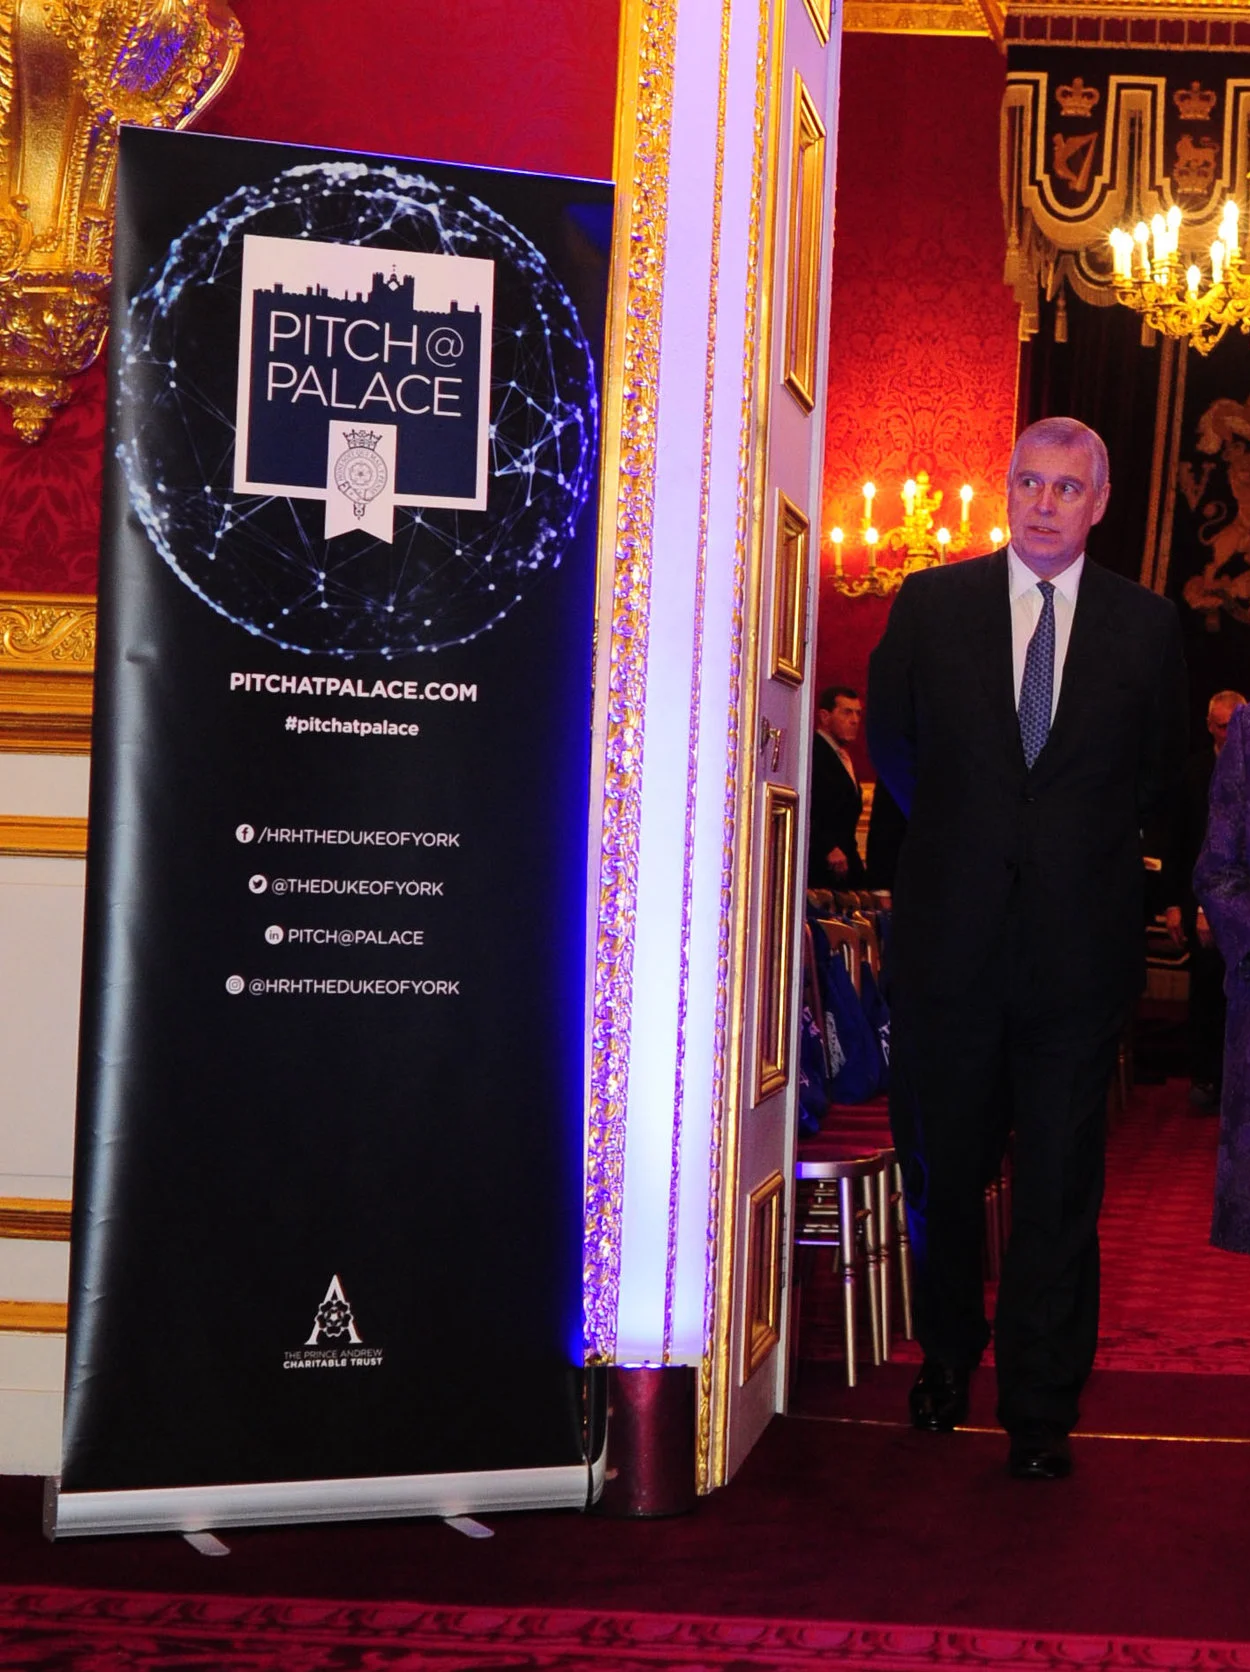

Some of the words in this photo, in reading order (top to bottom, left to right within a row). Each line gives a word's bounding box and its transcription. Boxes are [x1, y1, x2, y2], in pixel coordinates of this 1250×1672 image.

[267, 361, 463, 417] PALACE
[230, 672, 478, 702] PITCHATPALACE.COM
[284, 716, 419, 737] #pitchatpalace
[257, 826, 460, 848] /HRHTHEDUKEOFYORK
[271, 878, 444, 896] @THEDUKEOFYORK
[288, 928, 424, 946] PITCH@PALACE
[249, 978, 460, 996] @HRHTHEDUKEOFYORK
[283, 1351, 302, 1360] THE
[303, 1349, 338, 1359] PRINCE
[340, 1348, 383, 1358] ANDREW
[283, 1358, 347, 1369] CHARITABLE
[350, 1357, 383, 1367] TRUST
